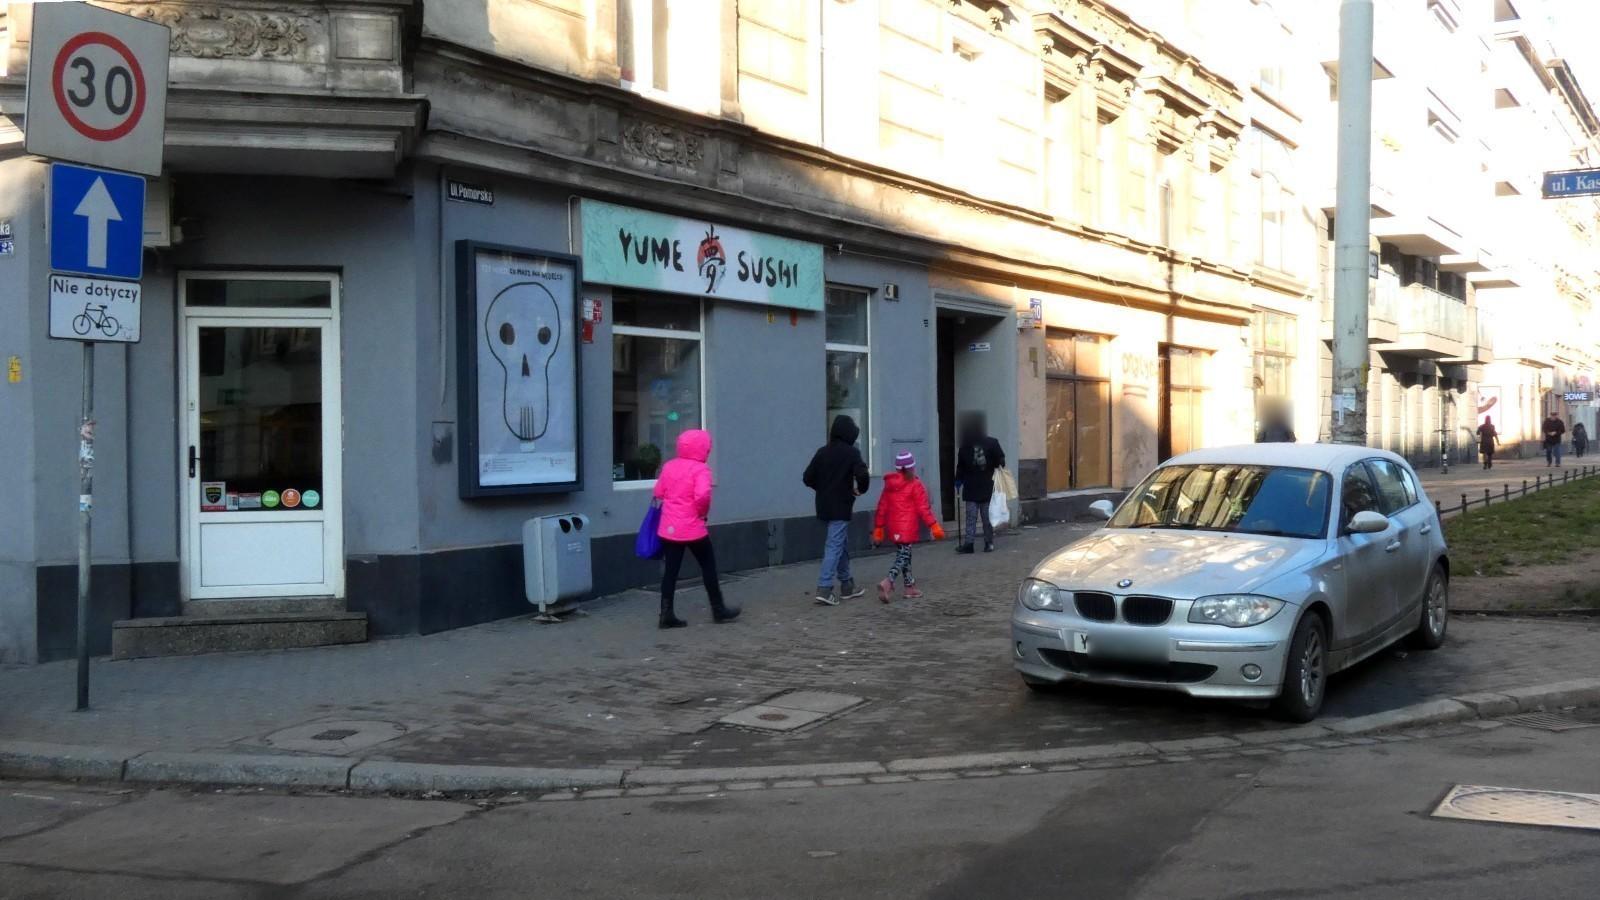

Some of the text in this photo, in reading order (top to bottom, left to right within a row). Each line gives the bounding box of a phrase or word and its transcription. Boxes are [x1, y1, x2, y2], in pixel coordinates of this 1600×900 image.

[67, 56, 133, 115] 30
[1552, 177, 1570, 191] ul.
[619, 227, 684, 272] YUME
[737, 251, 798, 288] SUSHI
[53, 279, 138, 303] Nie dotyczy
